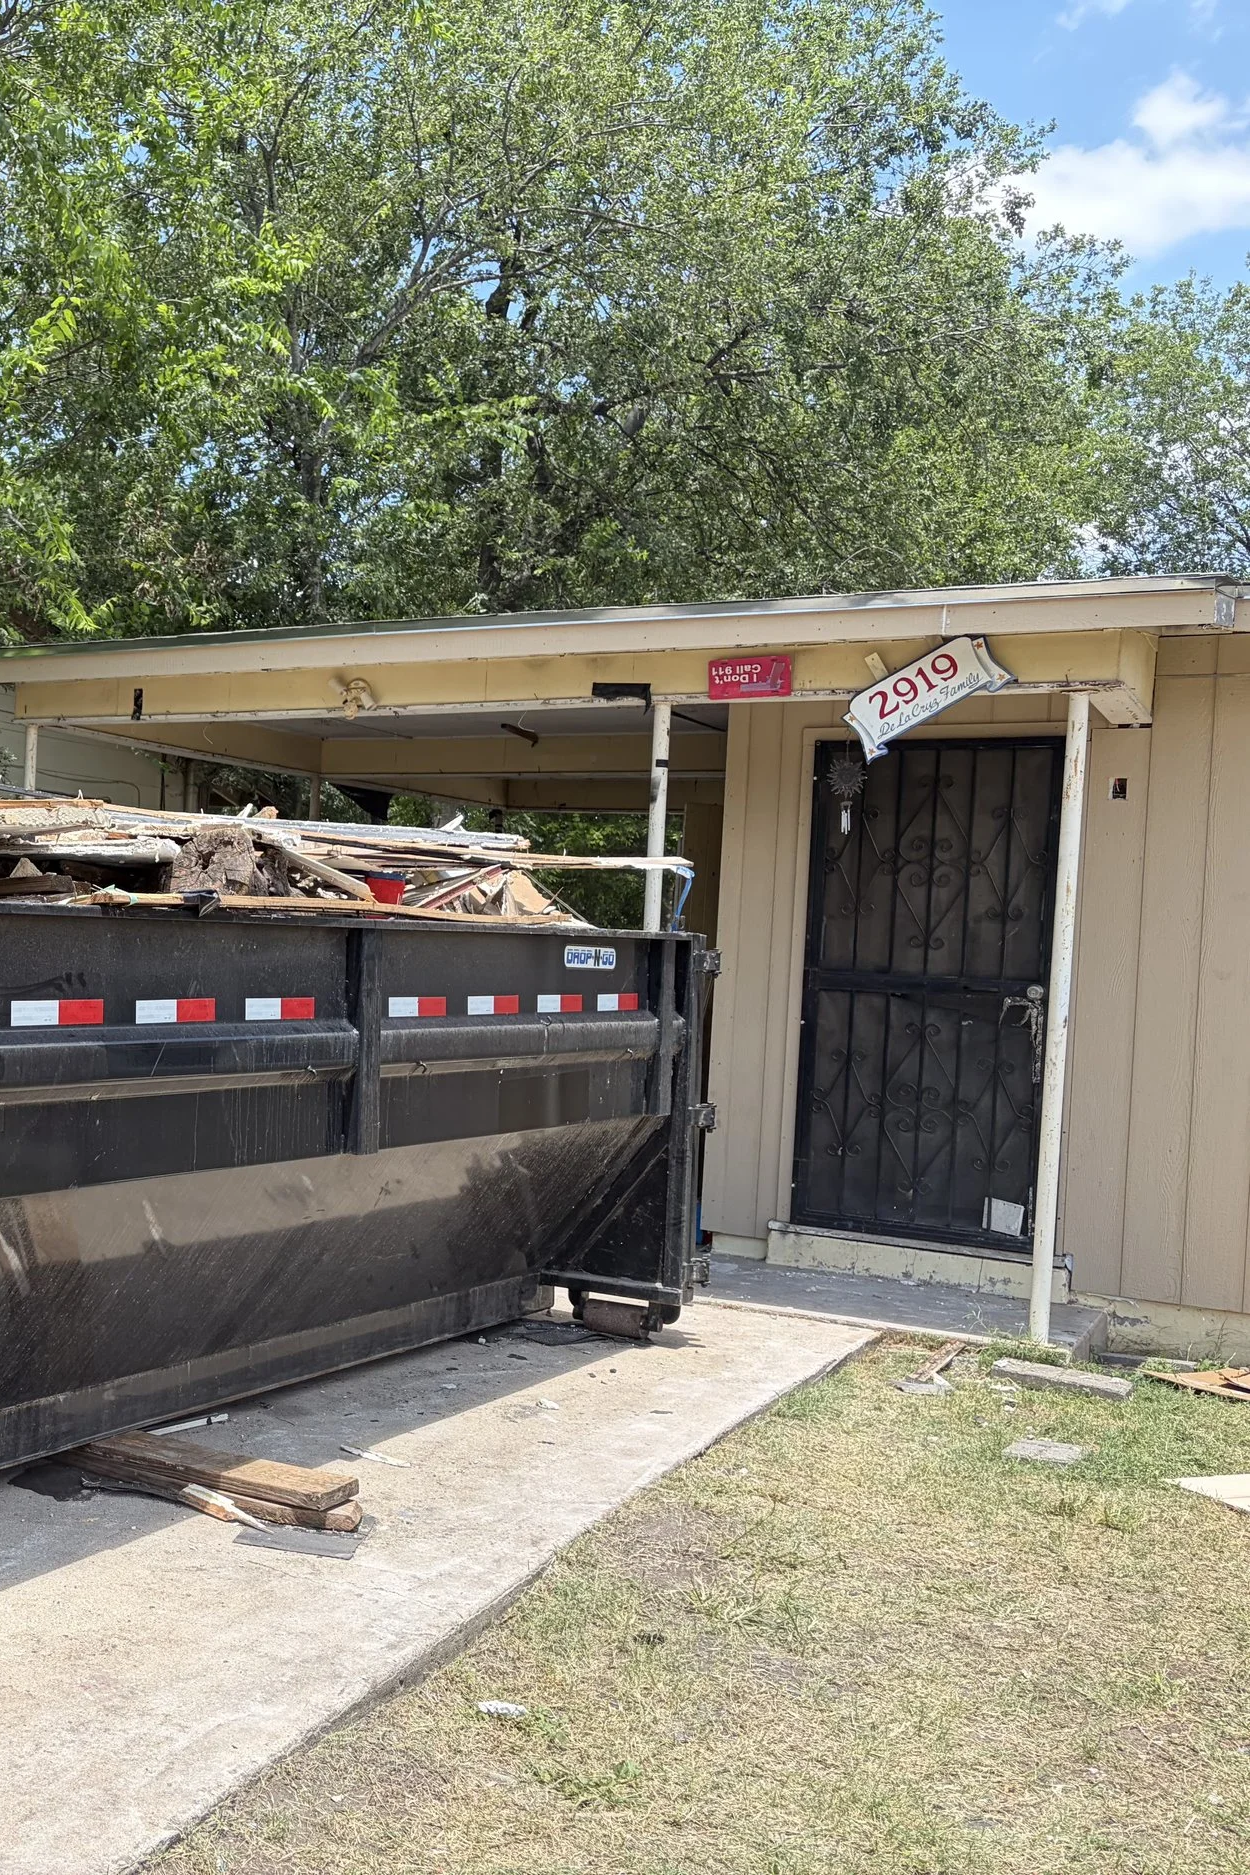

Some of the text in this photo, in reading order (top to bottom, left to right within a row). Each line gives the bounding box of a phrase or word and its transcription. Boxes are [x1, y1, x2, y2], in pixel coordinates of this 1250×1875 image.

[712, 664, 761, 676] Call 911
[714, 673, 757, 684] I Don't
[869, 653, 958, 720] 2919
[877, 672, 983, 739] De La Cruz Family
